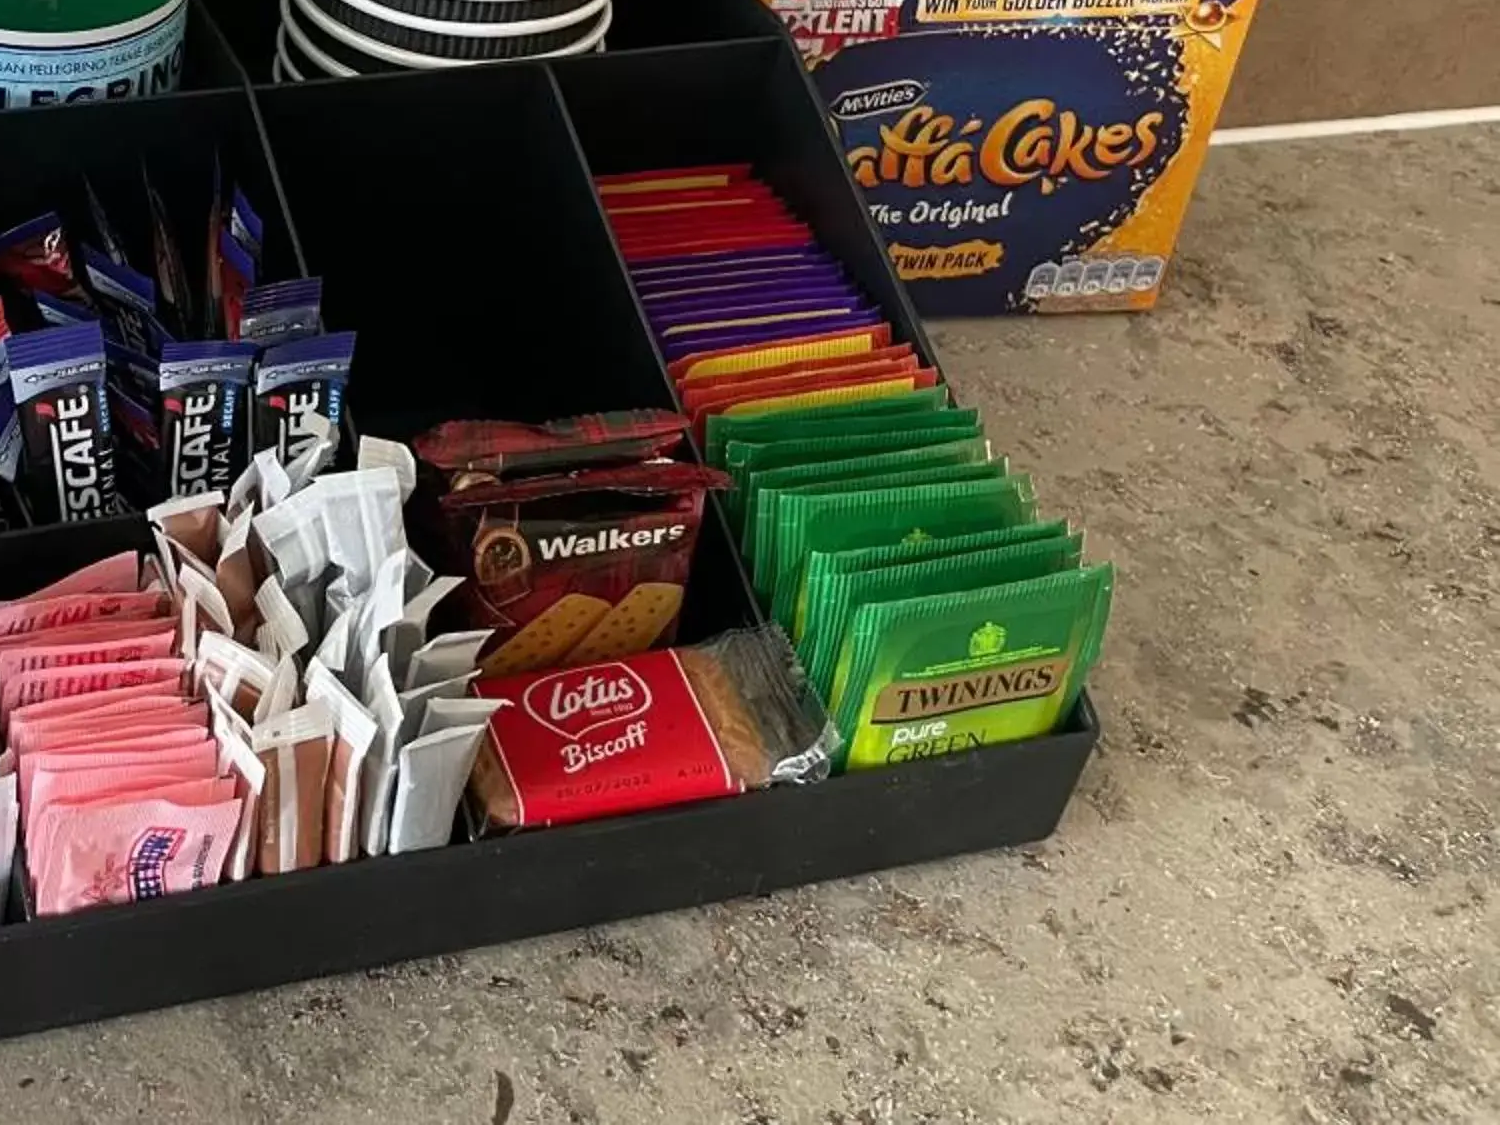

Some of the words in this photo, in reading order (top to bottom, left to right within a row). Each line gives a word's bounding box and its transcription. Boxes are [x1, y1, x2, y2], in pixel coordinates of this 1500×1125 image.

[846, 104, 972, 188] affa
[981, 96, 1165, 188] Cakes
[869, 203, 902, 225] The
[908, 191, 1013, 229] Original
[894, 253, 937, 270] TWIN
[941, 250, 989, 269] PACK
[329, 389, 342, 425] ECAFF
[538, 523, 687, 563] Walkers
[550, 676, 635, 720] Lotus
[897, 664, 1055, 714] TWININGS
[560, 720, 650, 775] Biscoff
[886, 727, 989, 765] GREEN
[891, 721, 948, 747] pure
